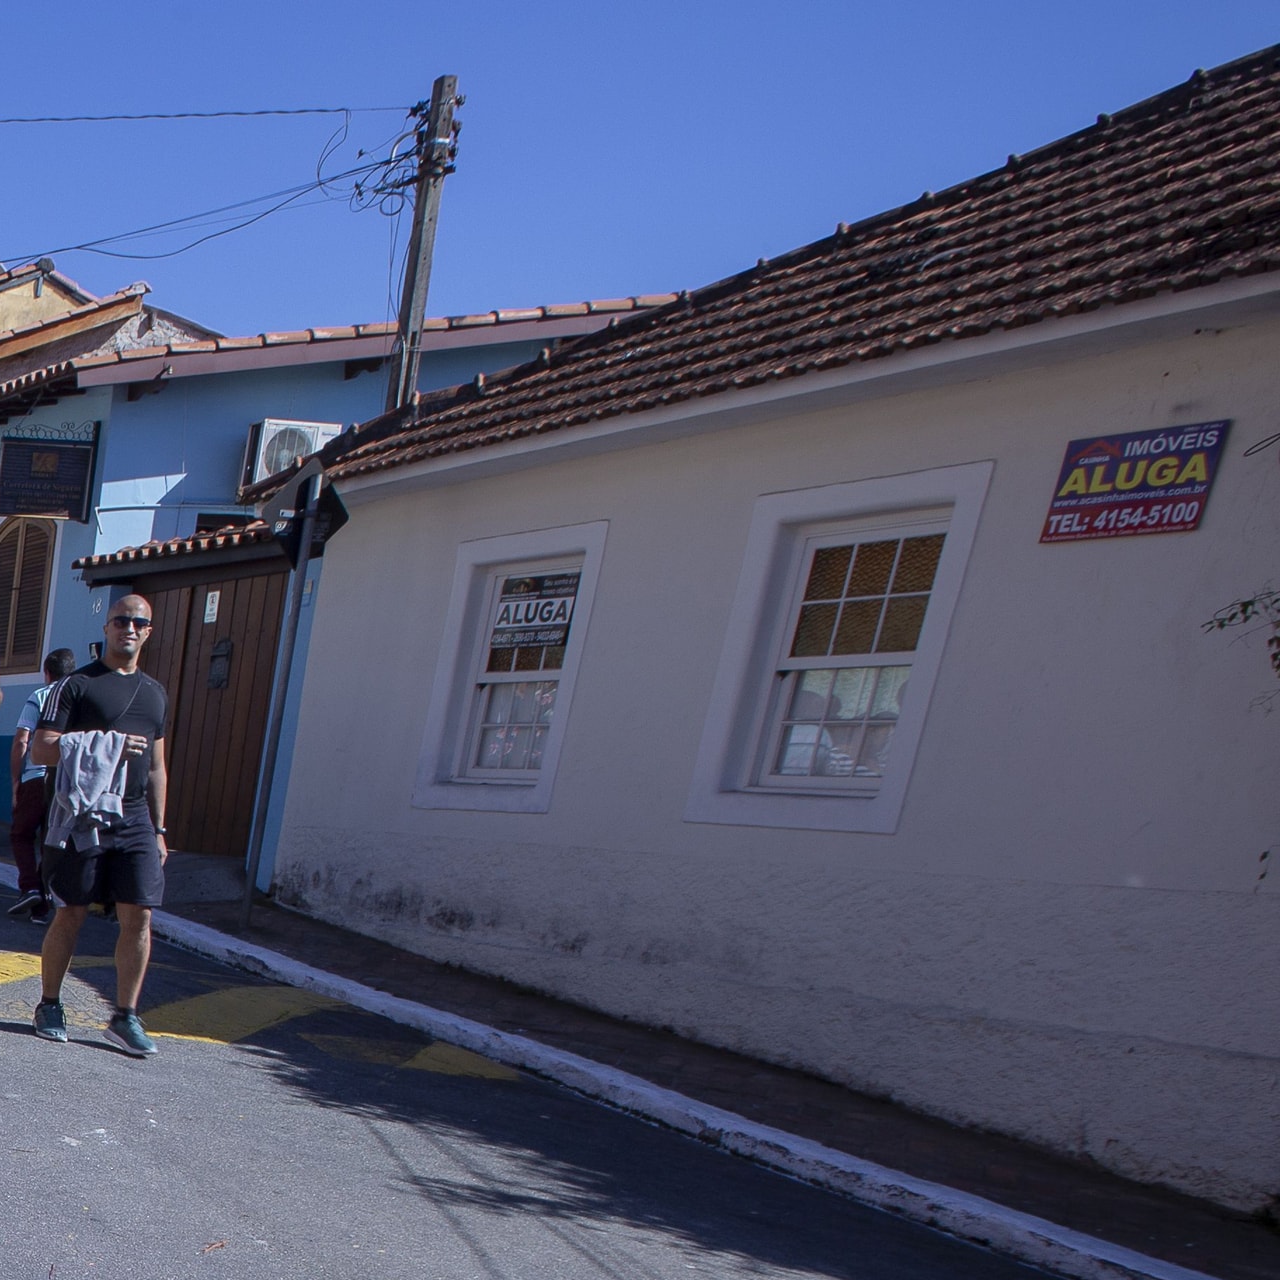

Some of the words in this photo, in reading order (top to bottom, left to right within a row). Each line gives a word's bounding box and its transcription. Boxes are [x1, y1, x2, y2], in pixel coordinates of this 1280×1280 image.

[1124, 430, 1219, 458] IMÓVEIS
[1058, 452, 1208, 497] ALUGA
[1049, 513, 1090, 535] TEL:
[1093, 501, 1200, 530] 4154-5100
[496, 600, 568, 625] ALUGA
